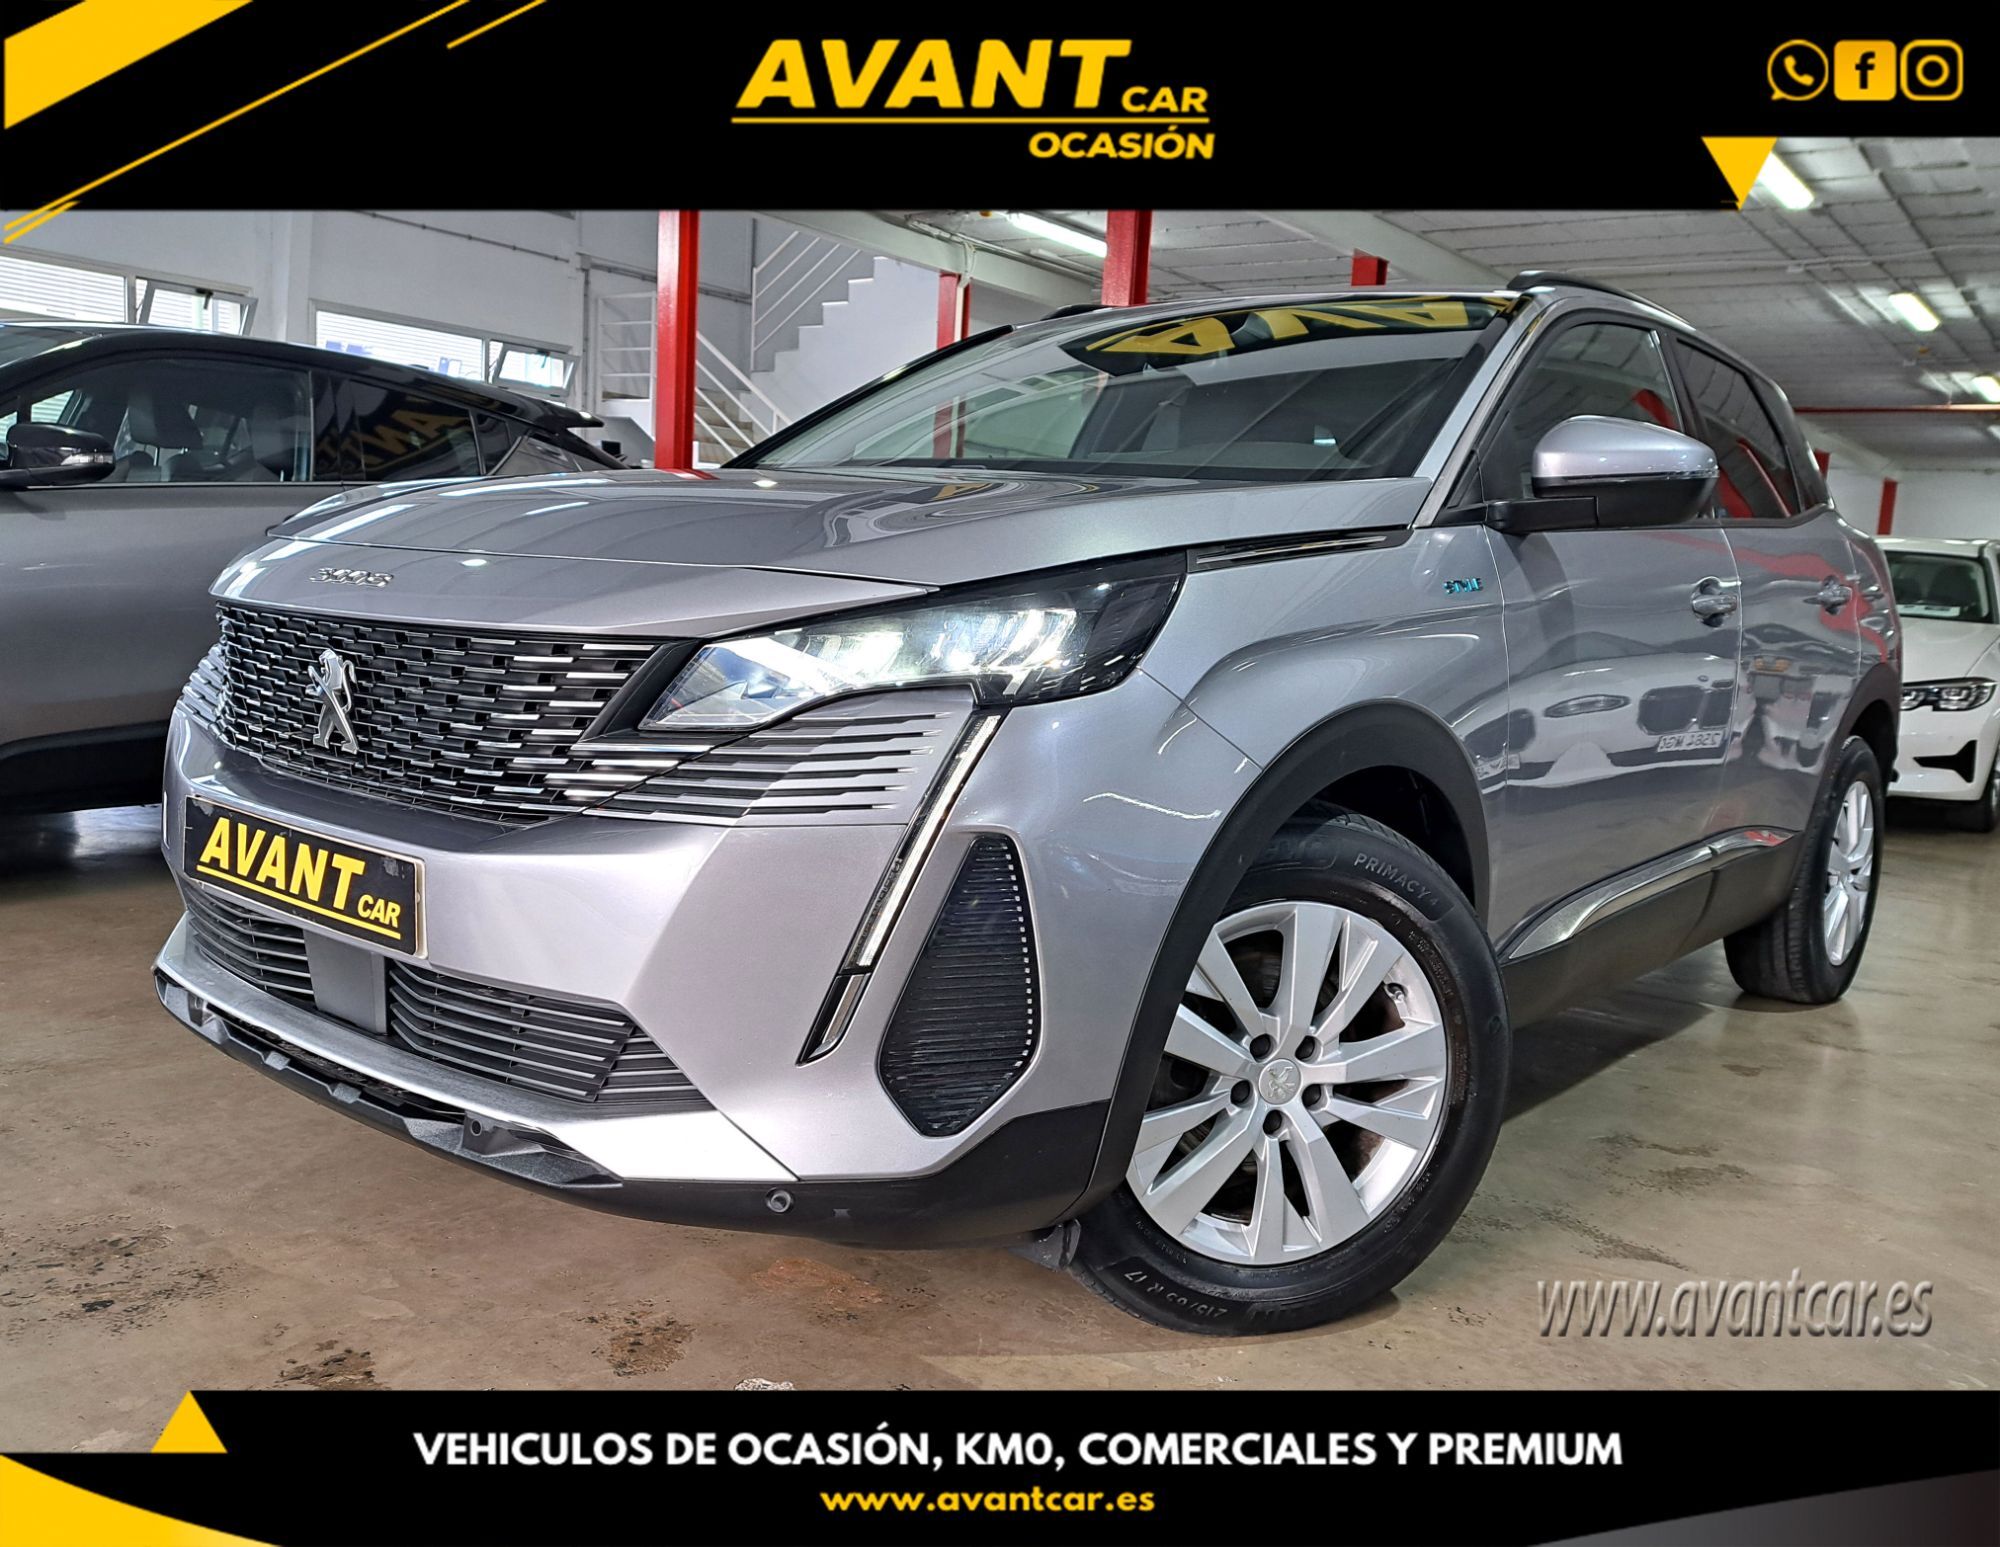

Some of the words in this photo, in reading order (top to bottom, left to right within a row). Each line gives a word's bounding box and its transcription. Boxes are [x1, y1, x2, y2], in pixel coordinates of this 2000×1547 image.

[200, 815, 366, 911] AVANT
[357, 893, 401, 928] CAR
[1354, 852, 1432, 900] PRIMACY
